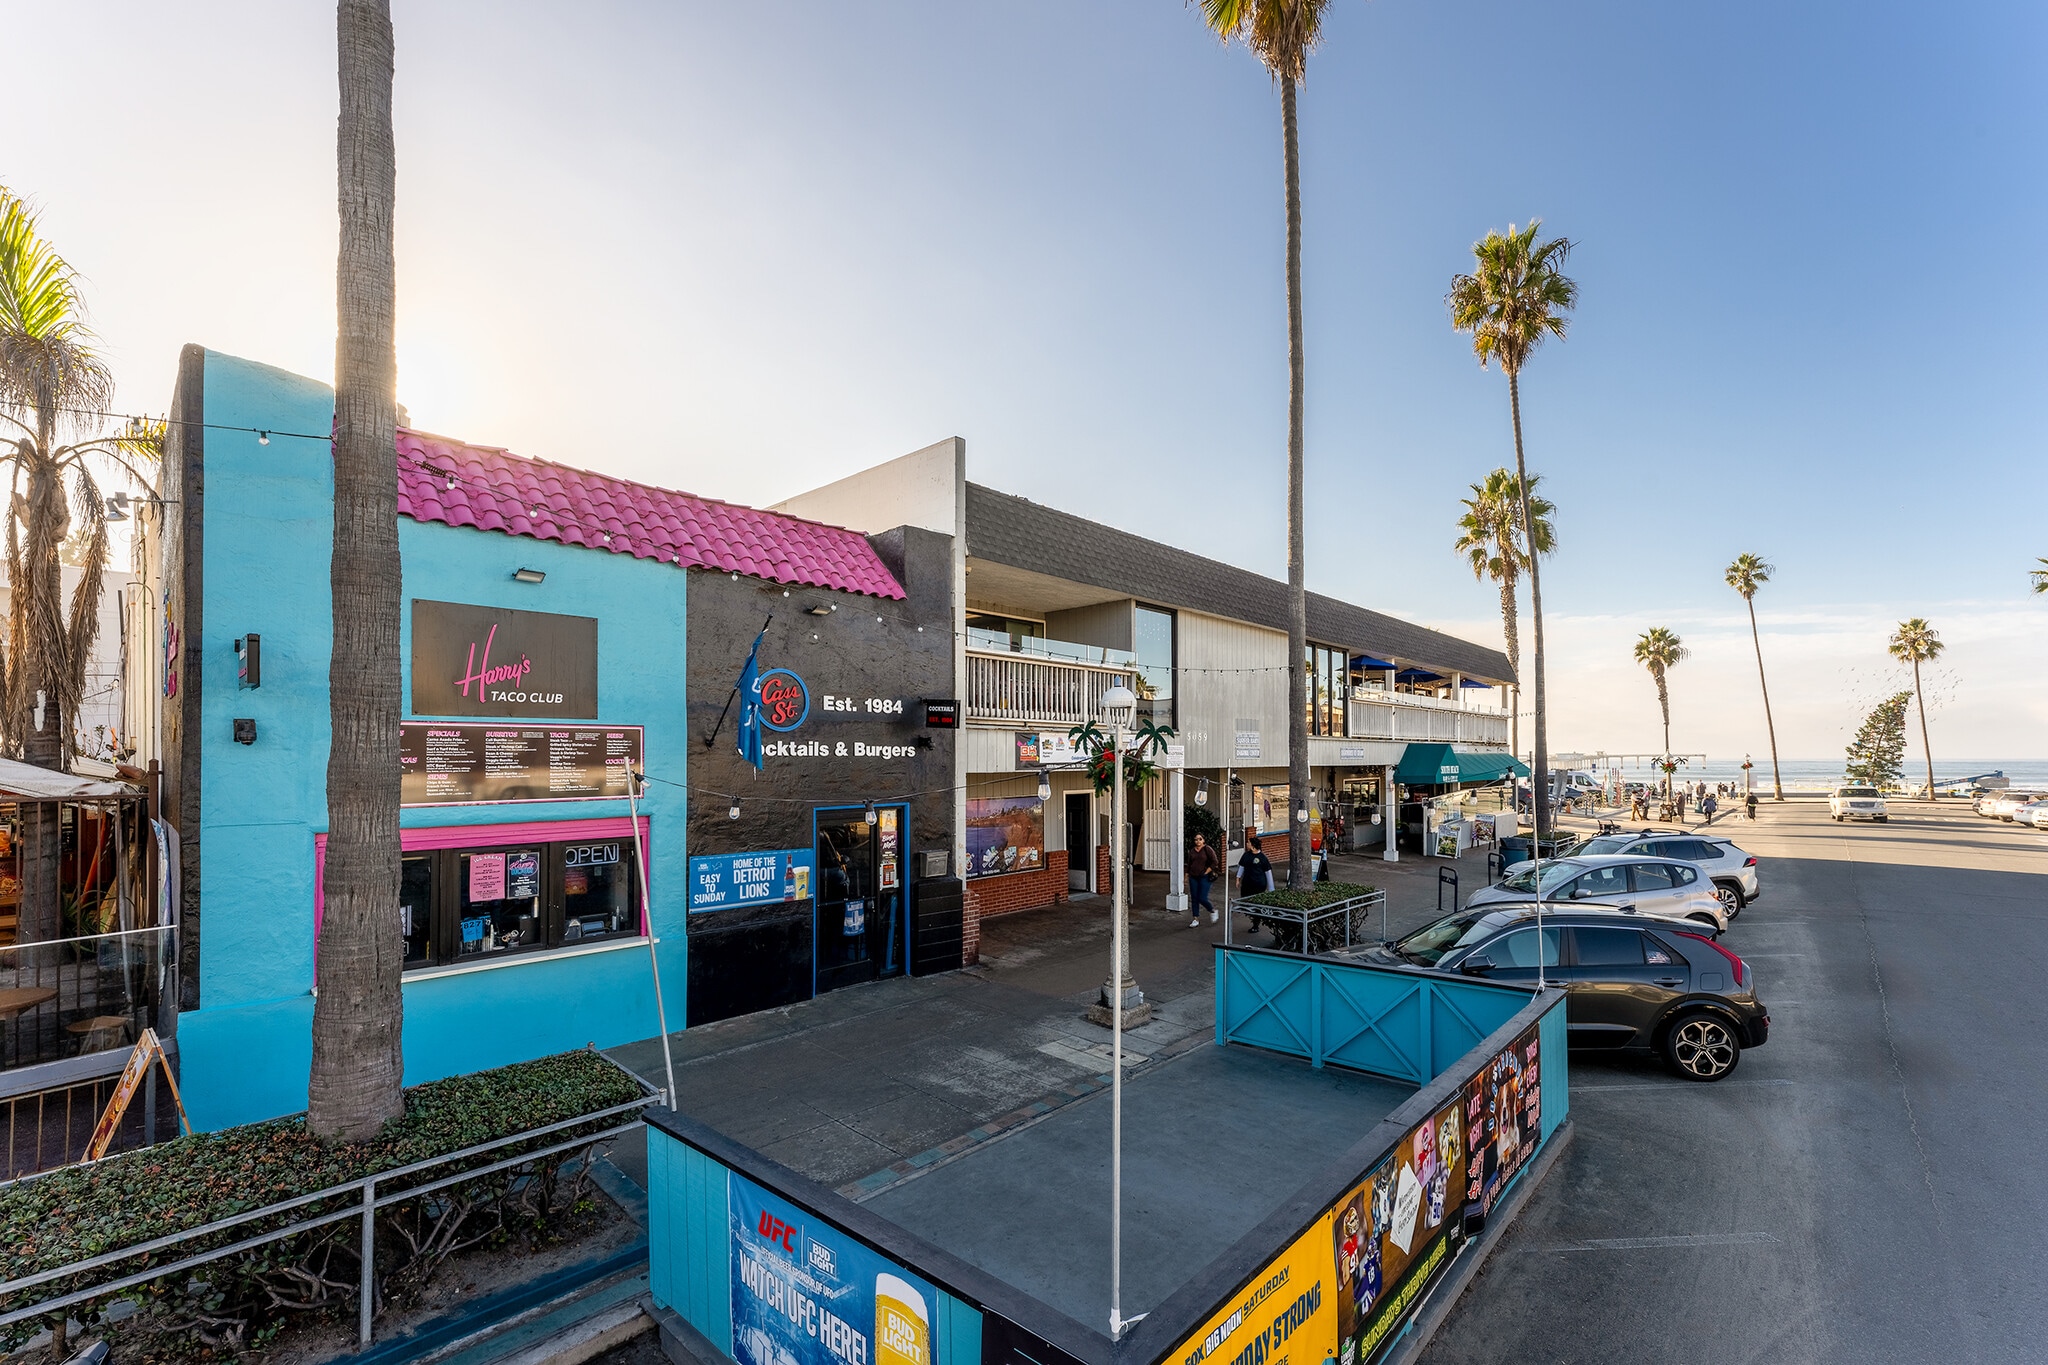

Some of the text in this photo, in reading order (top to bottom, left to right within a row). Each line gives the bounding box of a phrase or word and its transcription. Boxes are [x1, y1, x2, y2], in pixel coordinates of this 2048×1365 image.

[453, 624, 531, 703] Harry's
[491, 691, 563, 704] TACO CLUB
[762, 678, 800, 704] Cass
[771, 700, 798, 724] St.
[823, 696, 903, 714] Est. 1984
[1187, 732, 1208, 741] 5059
[738, 741, 916, 760] cktails & Burgers
[565, 845, 617, 864] OPEN
[733, 856, 776, 869] HOME OF THE
[700, 873, 721, 884] EASY
[733, 867, 776, 884] DETROIT
[705, 883, 716, 893] TO
[740, 882, 770, 899] LIONS
[694, 892, 726, 904] SUNDAY
[758, 1210, 797, 1253] UFC
[812, 1243, 831, 1262] BUD
[809, 1252, 835, 1275] LIGHT
[739, 1249, 867, 1365] WATCH UFC HERE!
[1205, 1326, 1222, 1356] BIG
[1243, 1265, 1290, 1315] SATURDAY
[1272, 1280, 1321, 1350] STRONG
[887, 1312, 916, 1342] BUD
[883, 1327, 922, 1363] LIGHT
